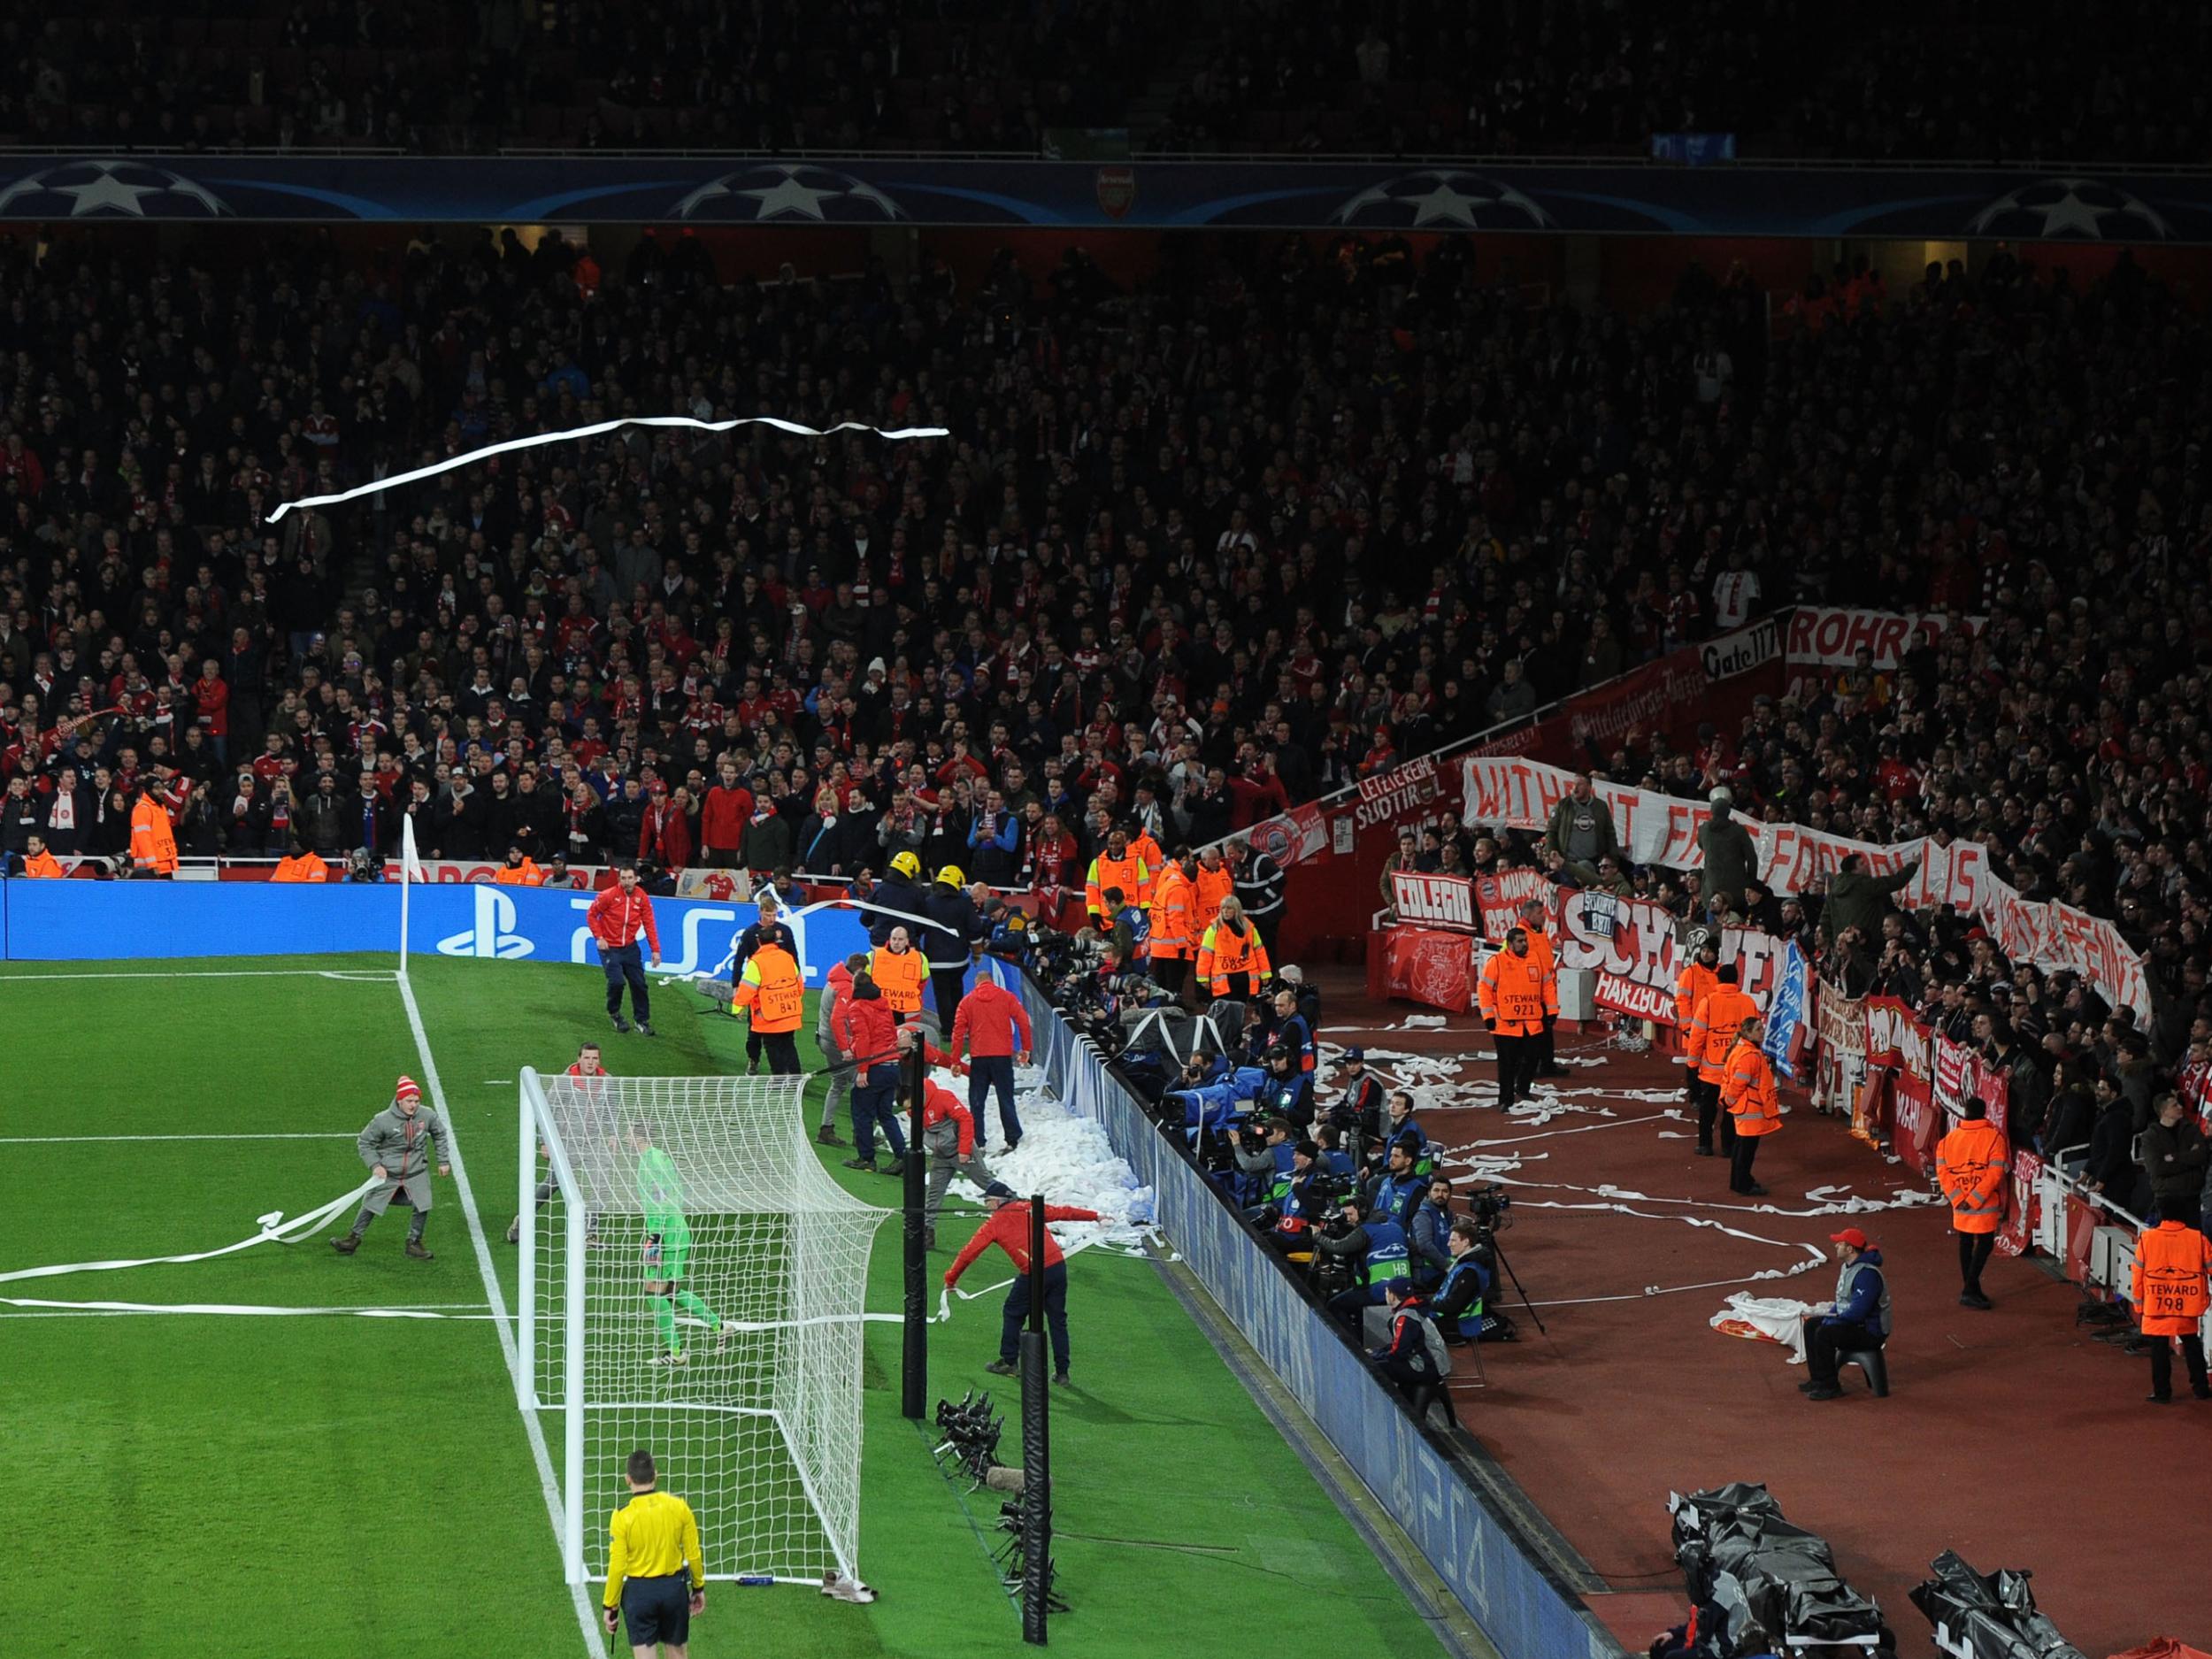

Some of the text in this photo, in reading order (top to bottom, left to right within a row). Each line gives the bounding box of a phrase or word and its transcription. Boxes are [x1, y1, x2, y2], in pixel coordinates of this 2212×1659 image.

[1472, 764, 1639, 852] WITHT
[1394, 876, 1473, 925] COLEGIO
[767, 989, 798, 1005] STEWAR
[880, 987, 917, 999] EWARD
[1503, 993, 1541, 1005] STEWAR
[1513, 1004, 1535, 1016] 921
[1392, 1263, 1406, 1276] HB
[2147, 1284, 2199, 1296] STEWARD
[2156, 1297, 2184, 1311] 798
